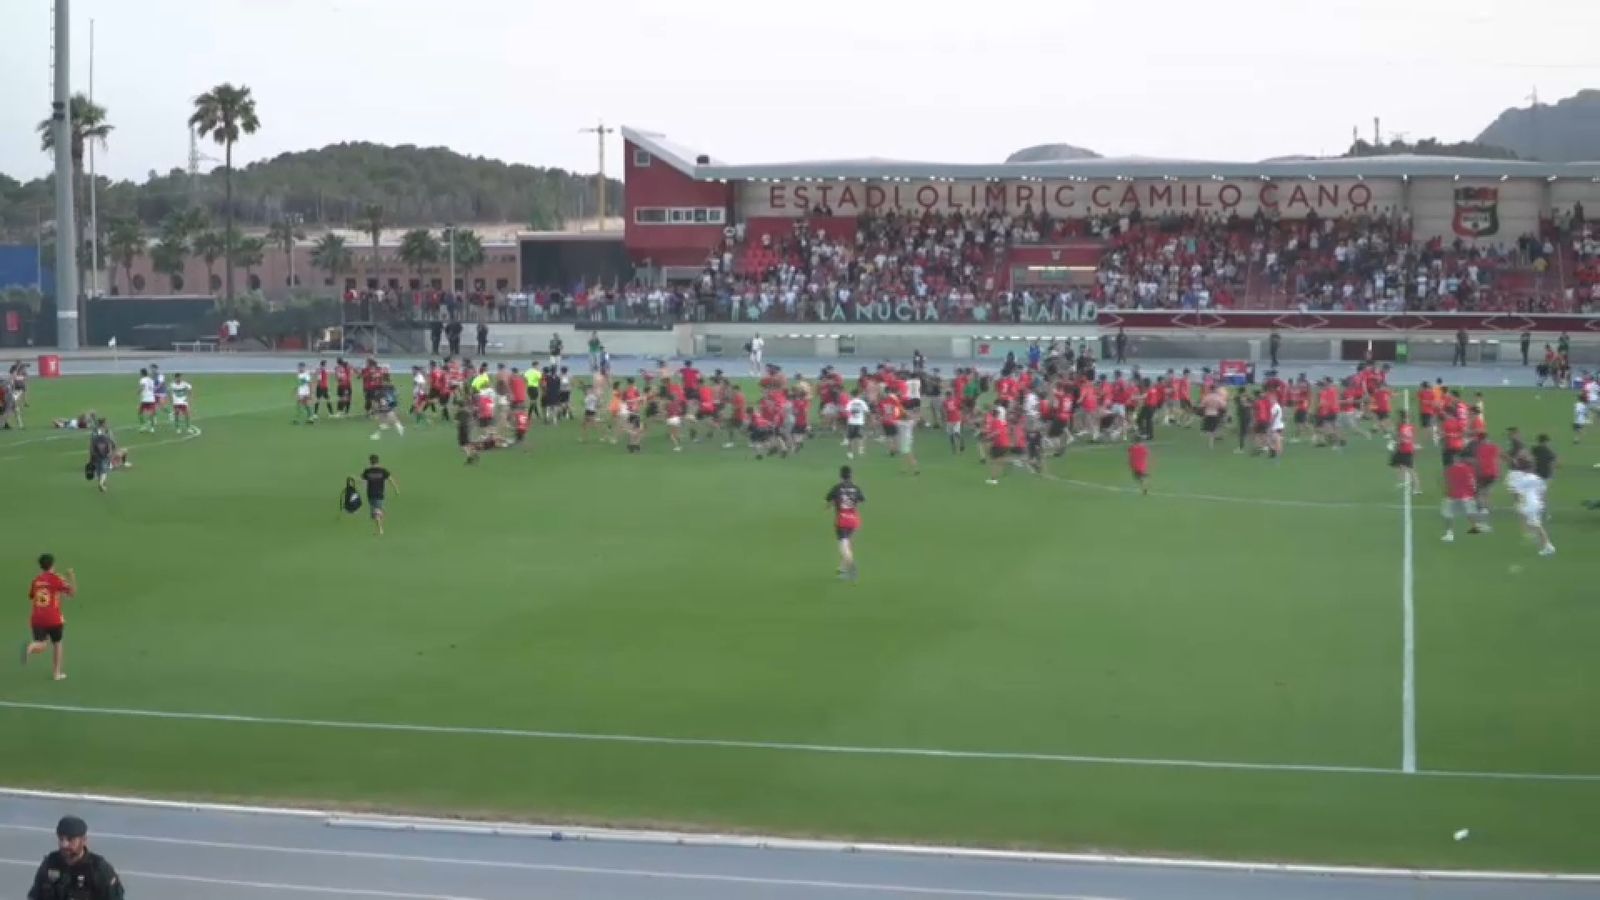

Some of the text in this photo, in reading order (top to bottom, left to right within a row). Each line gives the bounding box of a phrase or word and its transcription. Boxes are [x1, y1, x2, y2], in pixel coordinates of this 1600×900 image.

[769, 183, 1372, 209] ESTADI OLIMPIC CAMILO CANO
